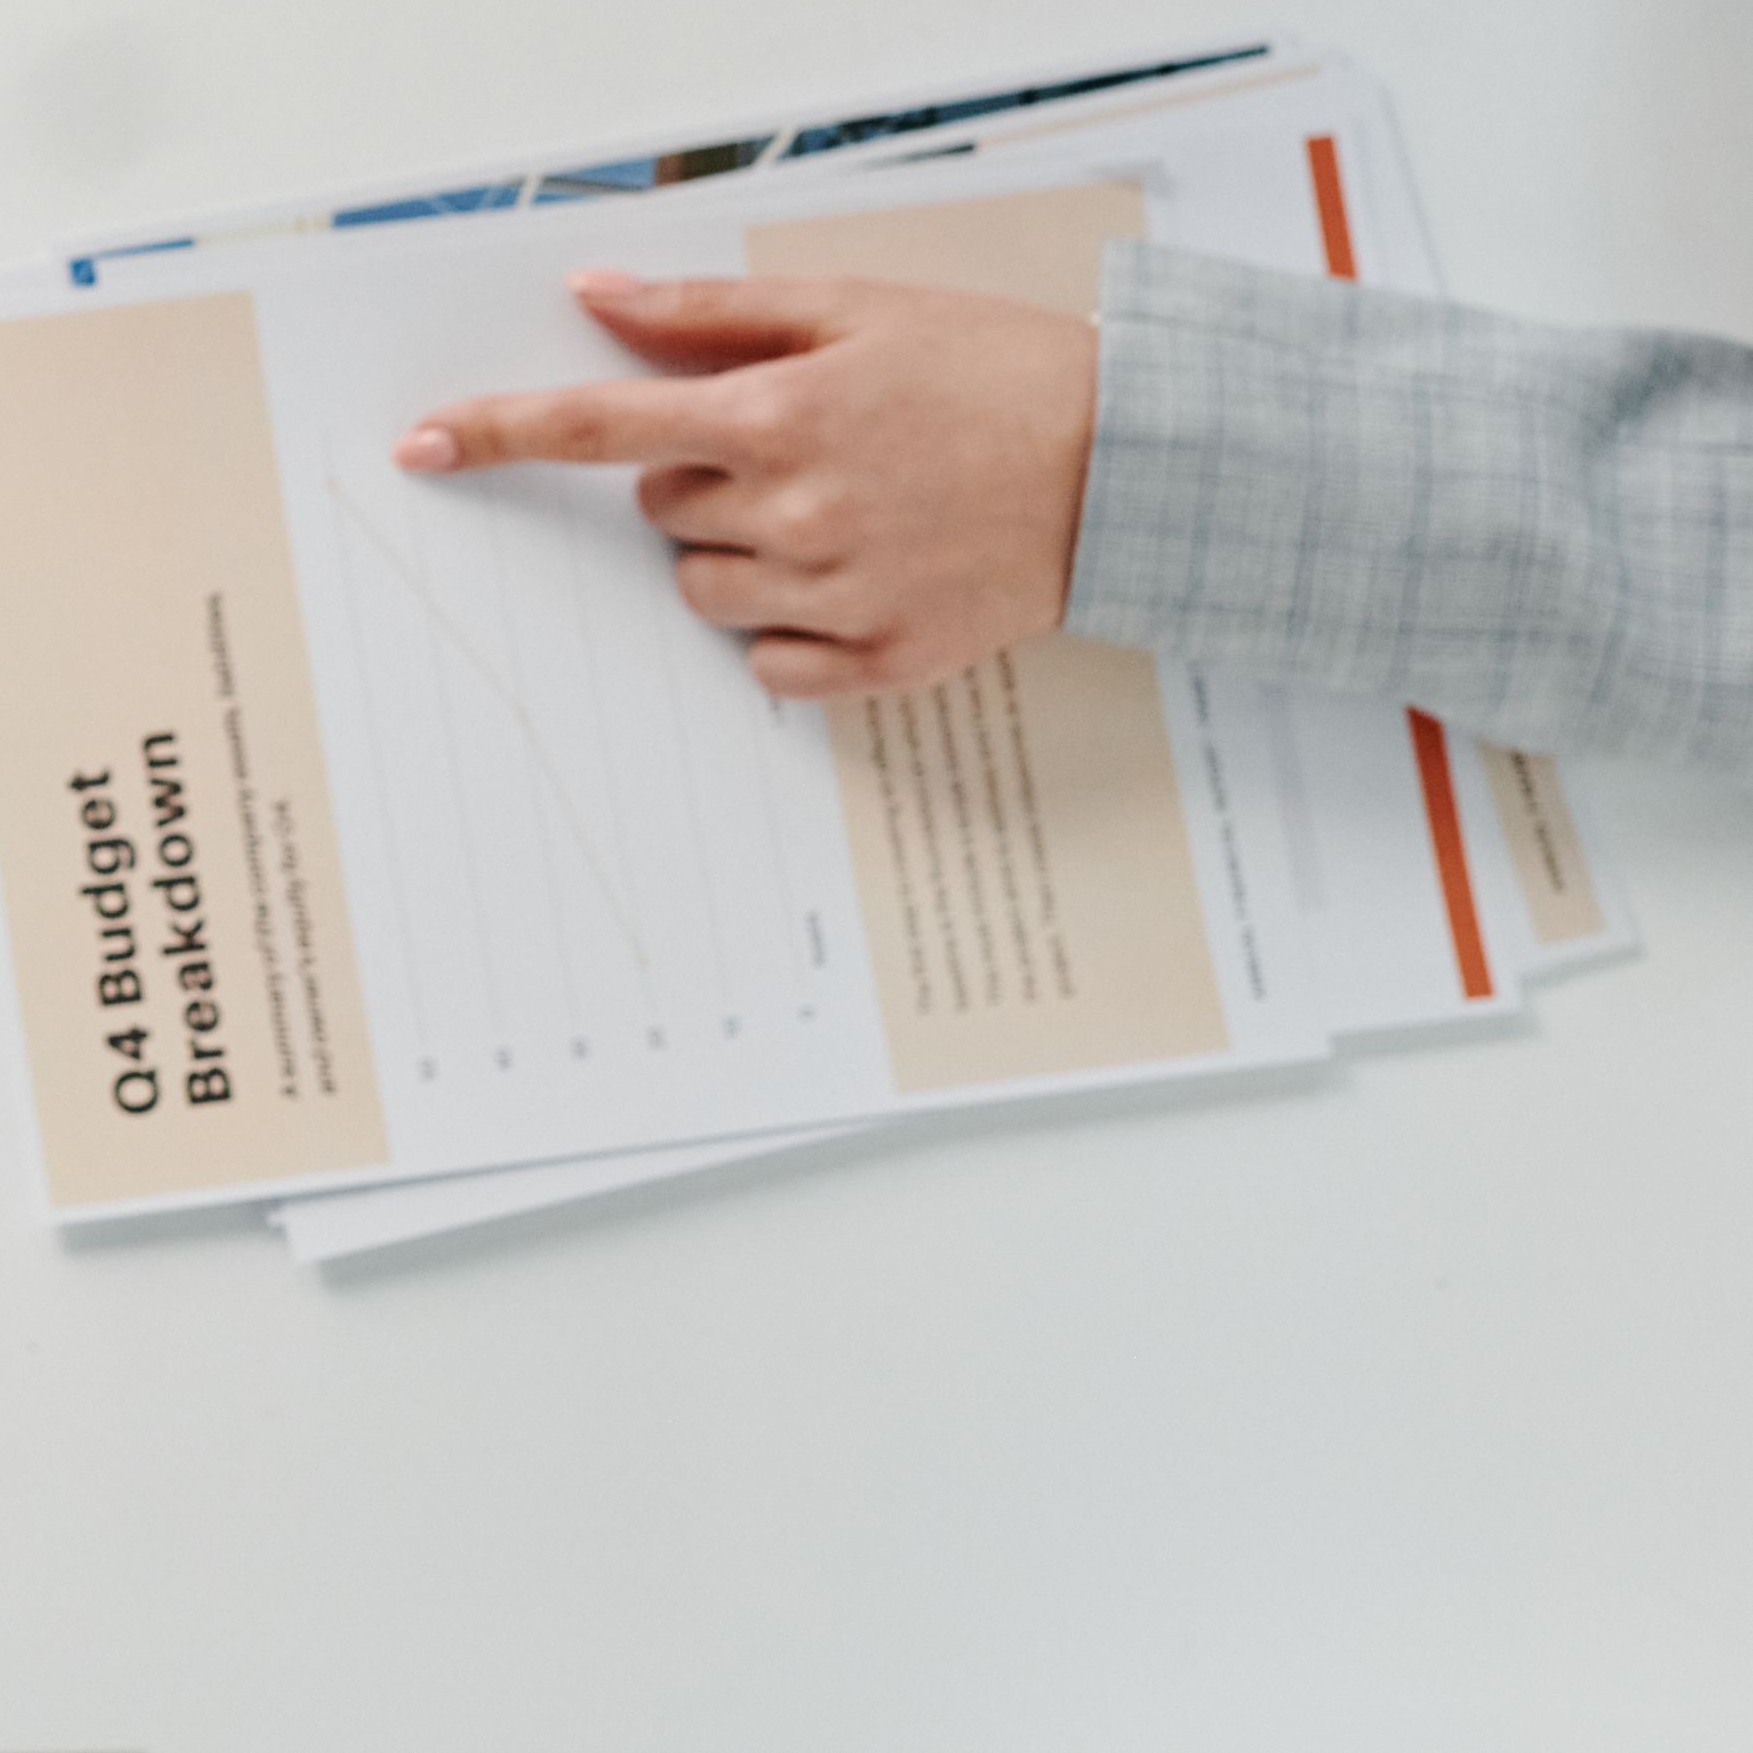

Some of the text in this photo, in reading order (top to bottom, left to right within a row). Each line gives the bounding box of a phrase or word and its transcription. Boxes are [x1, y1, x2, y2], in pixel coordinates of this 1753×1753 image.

[65, 766, 163, 1116] Q4 Budget
[140, 730, 236, 1110] Breakdown
